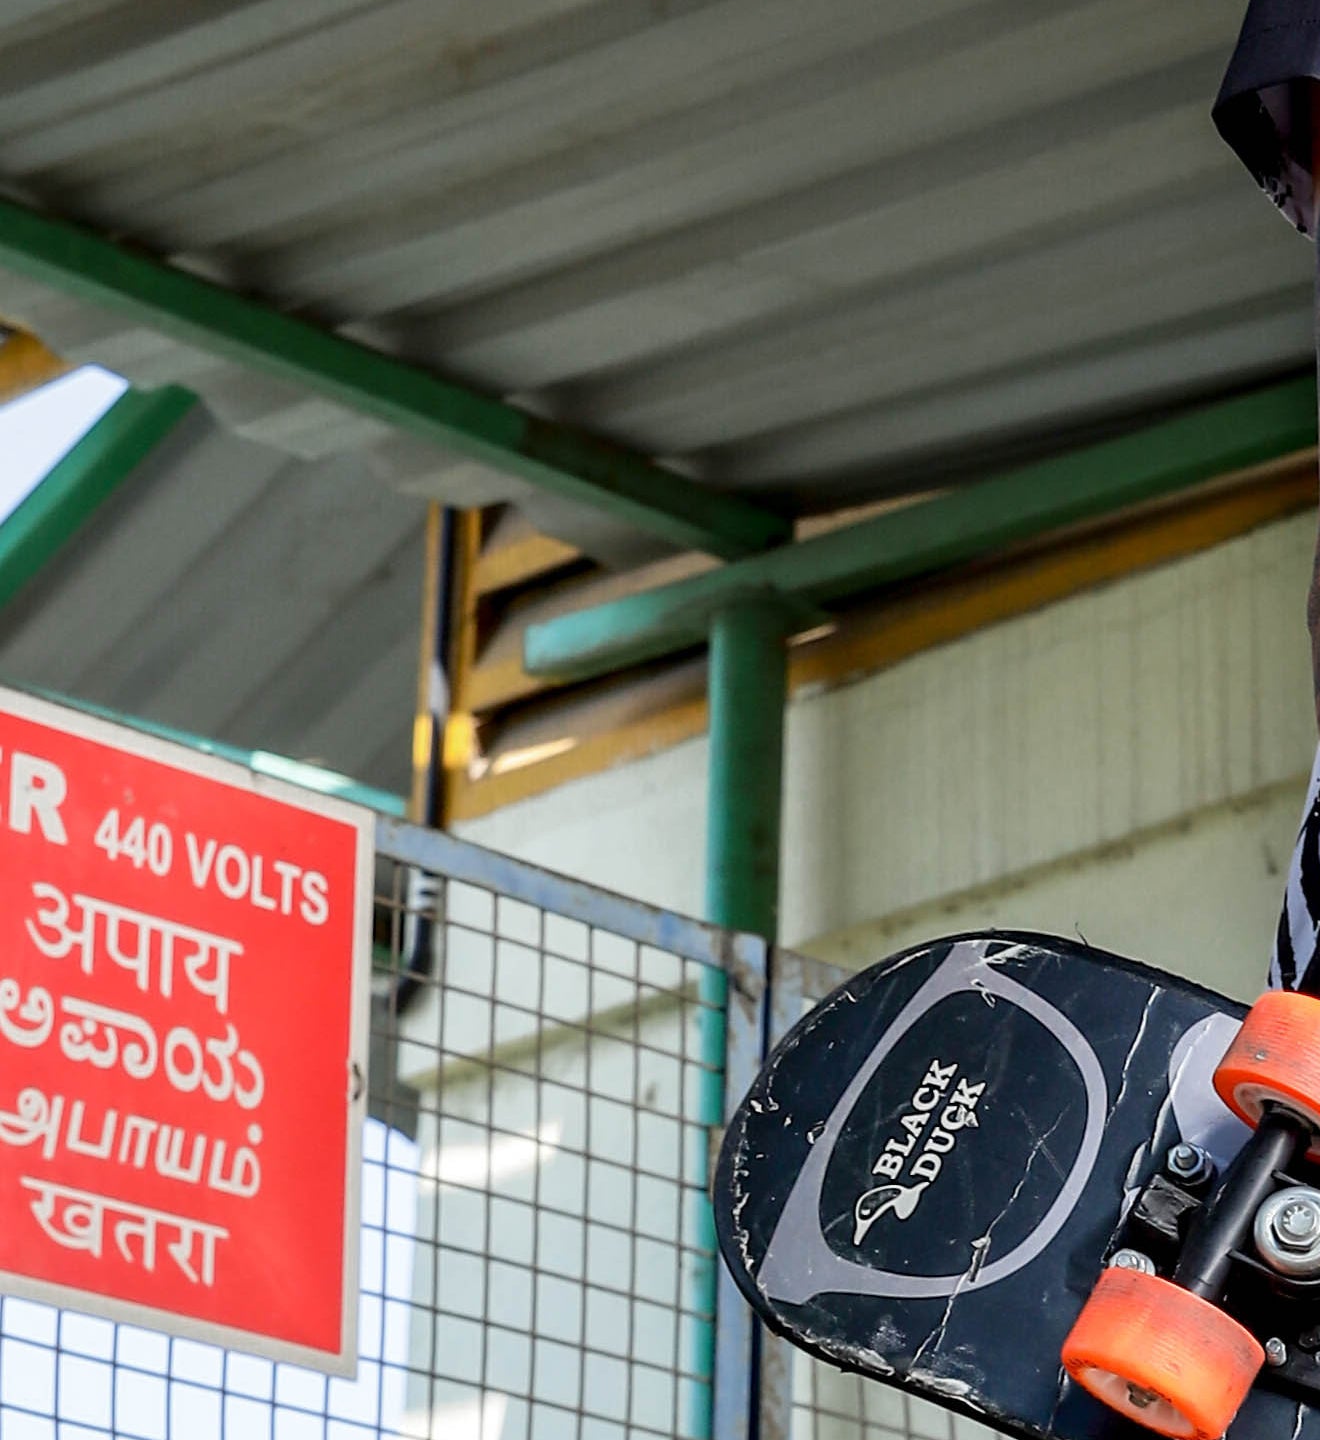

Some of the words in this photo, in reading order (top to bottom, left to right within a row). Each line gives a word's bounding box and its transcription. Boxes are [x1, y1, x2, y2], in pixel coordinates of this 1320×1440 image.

[0, 746, 68, 846] R
[94, 808, 173, 877] 440
[185, 831, 329, 926] VOLTS
[25, 881, 244, 1015] अपाय
[0, 978, 265, 1110] ಅಪಾಯ
[0, 1087, 263, 1198] அபாயம்
[872, 1060, 958, 1180] BLACK
[910, 1078, 986, 1181] DUCK
[20, 1175, 230, 1287] खतरा
